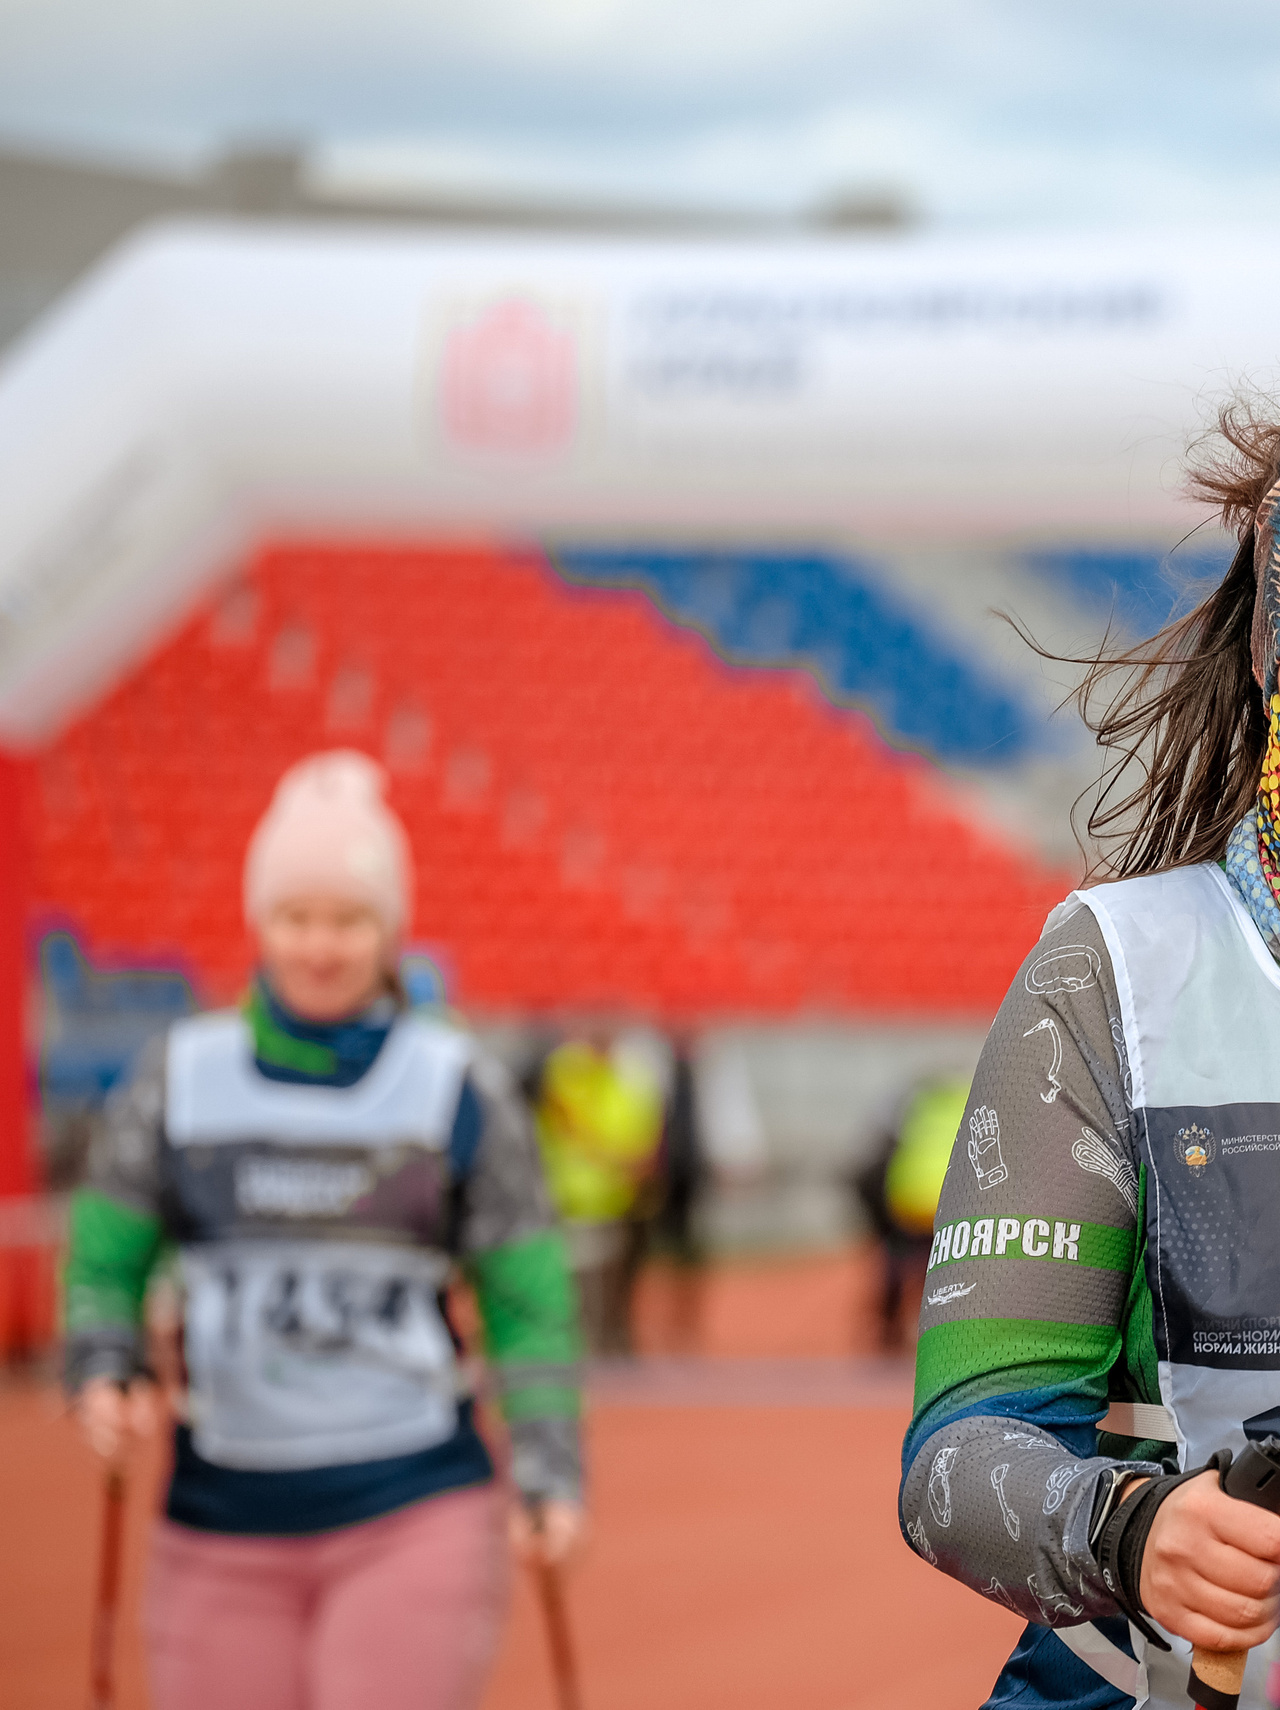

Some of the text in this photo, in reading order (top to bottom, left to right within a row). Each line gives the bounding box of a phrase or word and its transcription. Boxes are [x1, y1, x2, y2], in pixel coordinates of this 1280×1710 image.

[1222, 1142, 1280, 1155] РОССИЙСКОЙ
[932, 1282, 966, 1298] LIBERTY
[1193, 1330, 1232, 1342] СПОРТ
[1193, 1341, 1241, 1354] НОРМА
